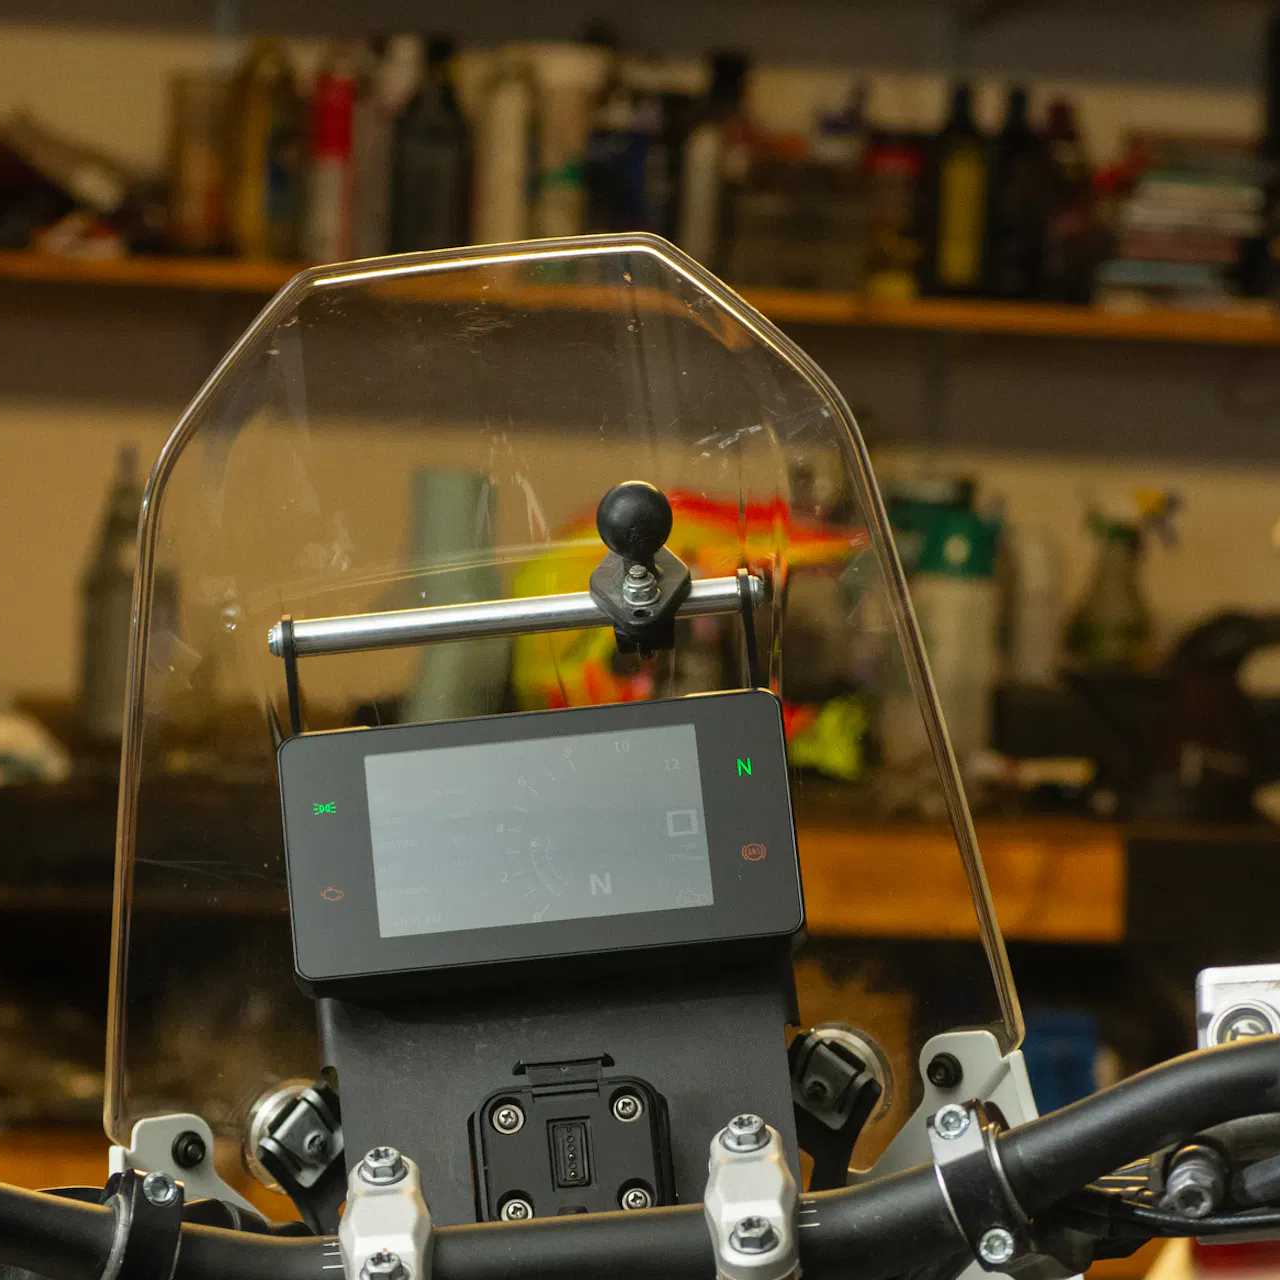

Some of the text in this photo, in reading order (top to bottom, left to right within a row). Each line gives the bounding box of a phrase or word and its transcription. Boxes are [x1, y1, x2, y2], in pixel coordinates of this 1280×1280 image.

[664, 757, 680, 770] 12
[737, 757, 753, 776] N
[589, 872, 612, 896] N
